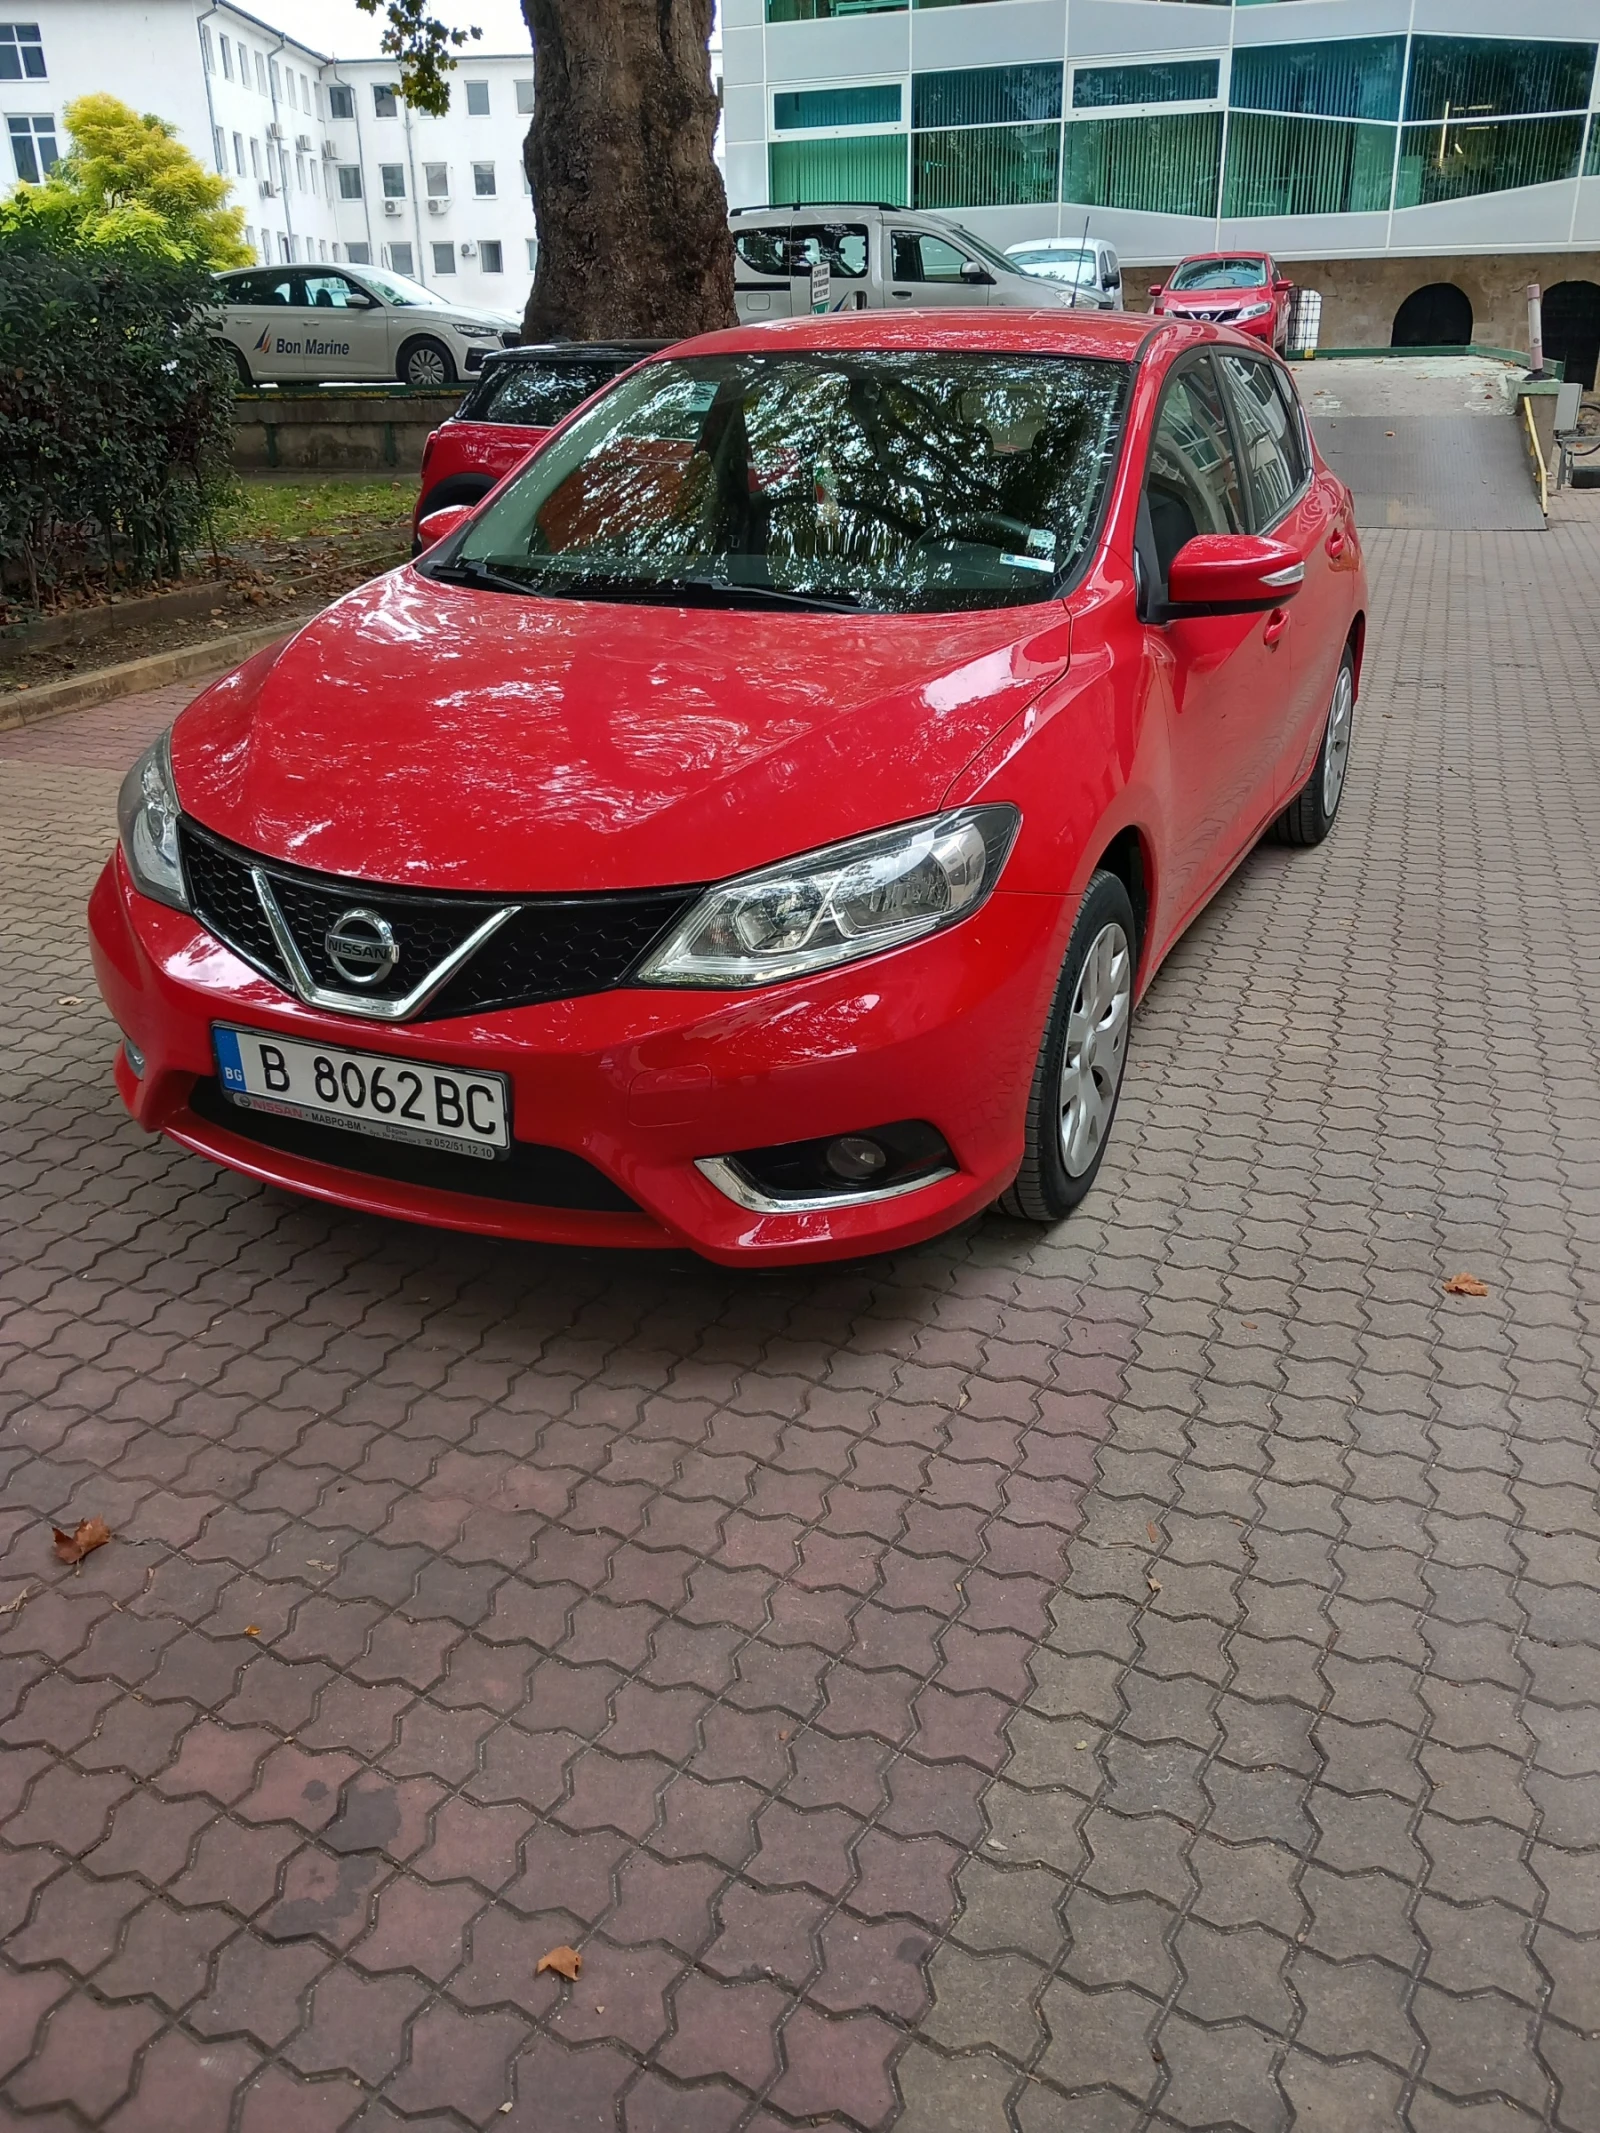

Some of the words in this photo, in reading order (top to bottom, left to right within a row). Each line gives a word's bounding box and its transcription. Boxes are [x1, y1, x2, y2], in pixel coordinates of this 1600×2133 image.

[276, 338, 301, 354] Bon
[305, 338, 350, 355] Marine
[328, 939, 388, 960] NISSAN
[224, 1067, 242, 1082] BG
[258, 1044, 290, 1092] B
[253, 1098, 303, 1119] NISSAN
[467, 1144, 479, 1155] 12
[481, 1147, 492, 1158] 10
